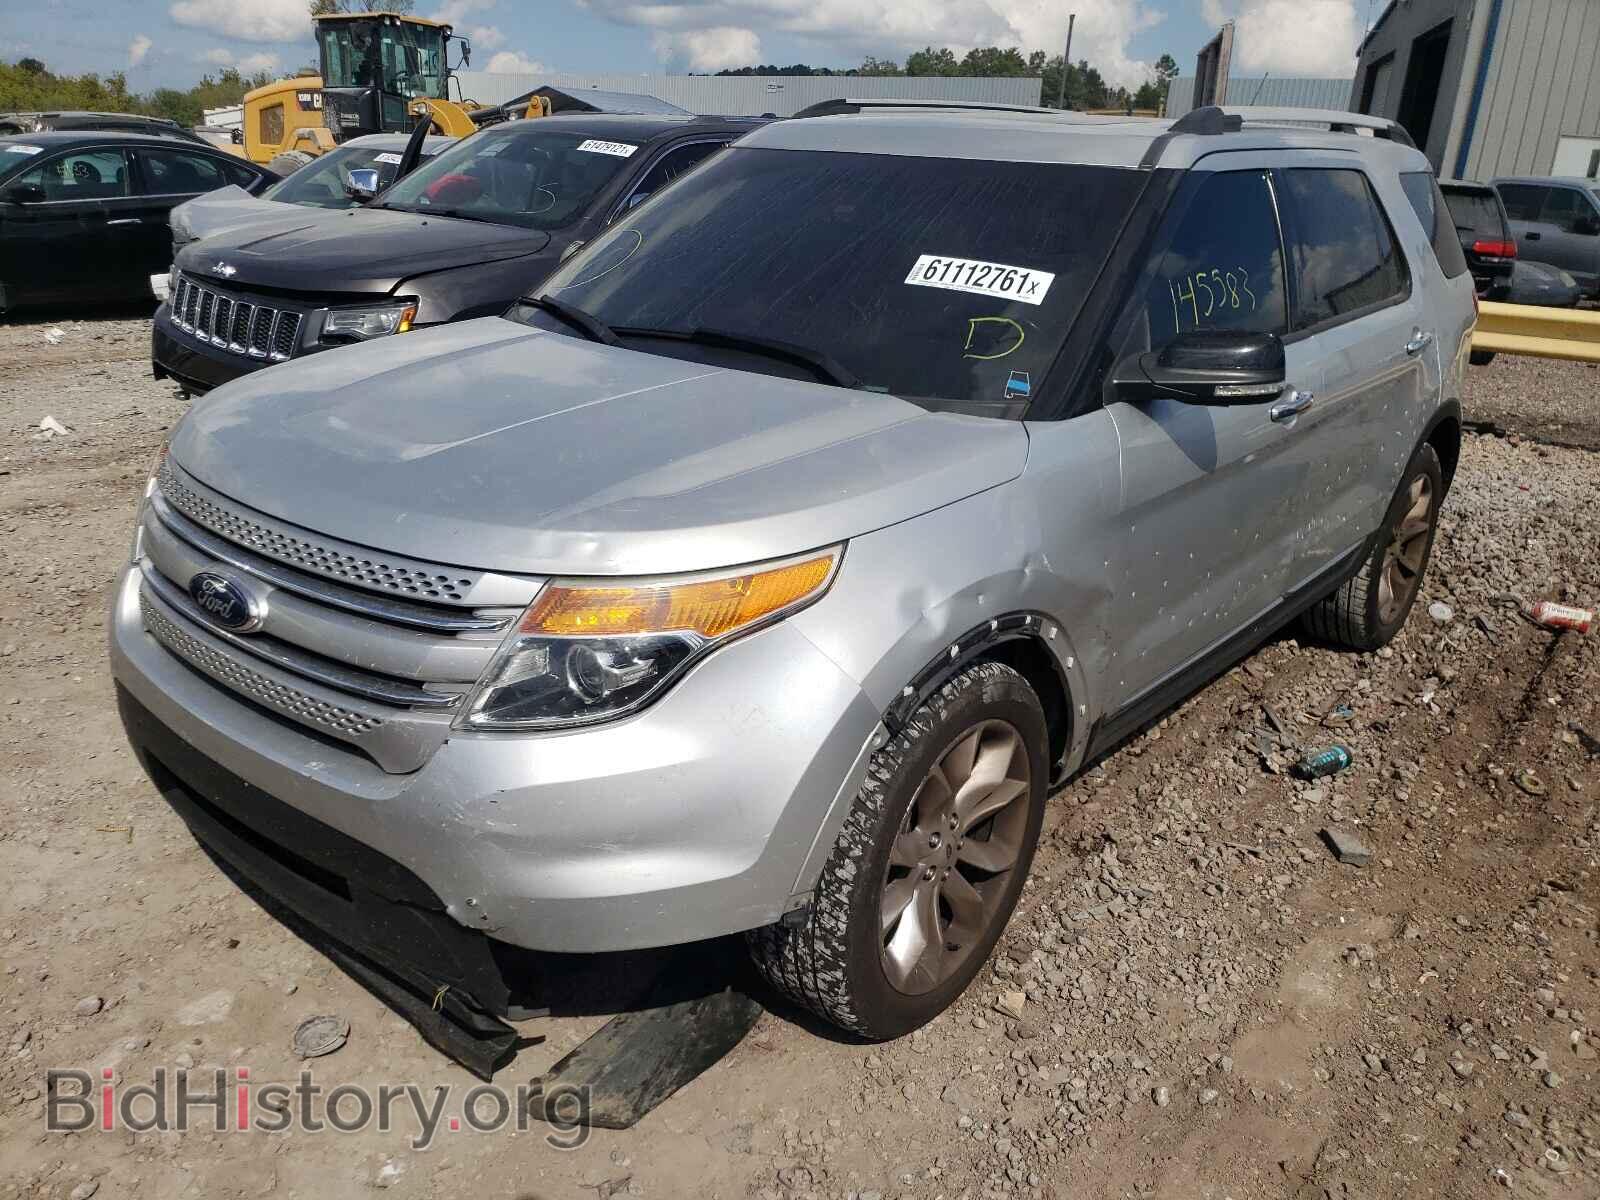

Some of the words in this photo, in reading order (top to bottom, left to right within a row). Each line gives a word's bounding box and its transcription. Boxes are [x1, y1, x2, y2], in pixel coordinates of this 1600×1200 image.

[313, 93, 323, 108] CA
[961, 316, 1025, 360] D
[197, 578, 235, 618] Ford
